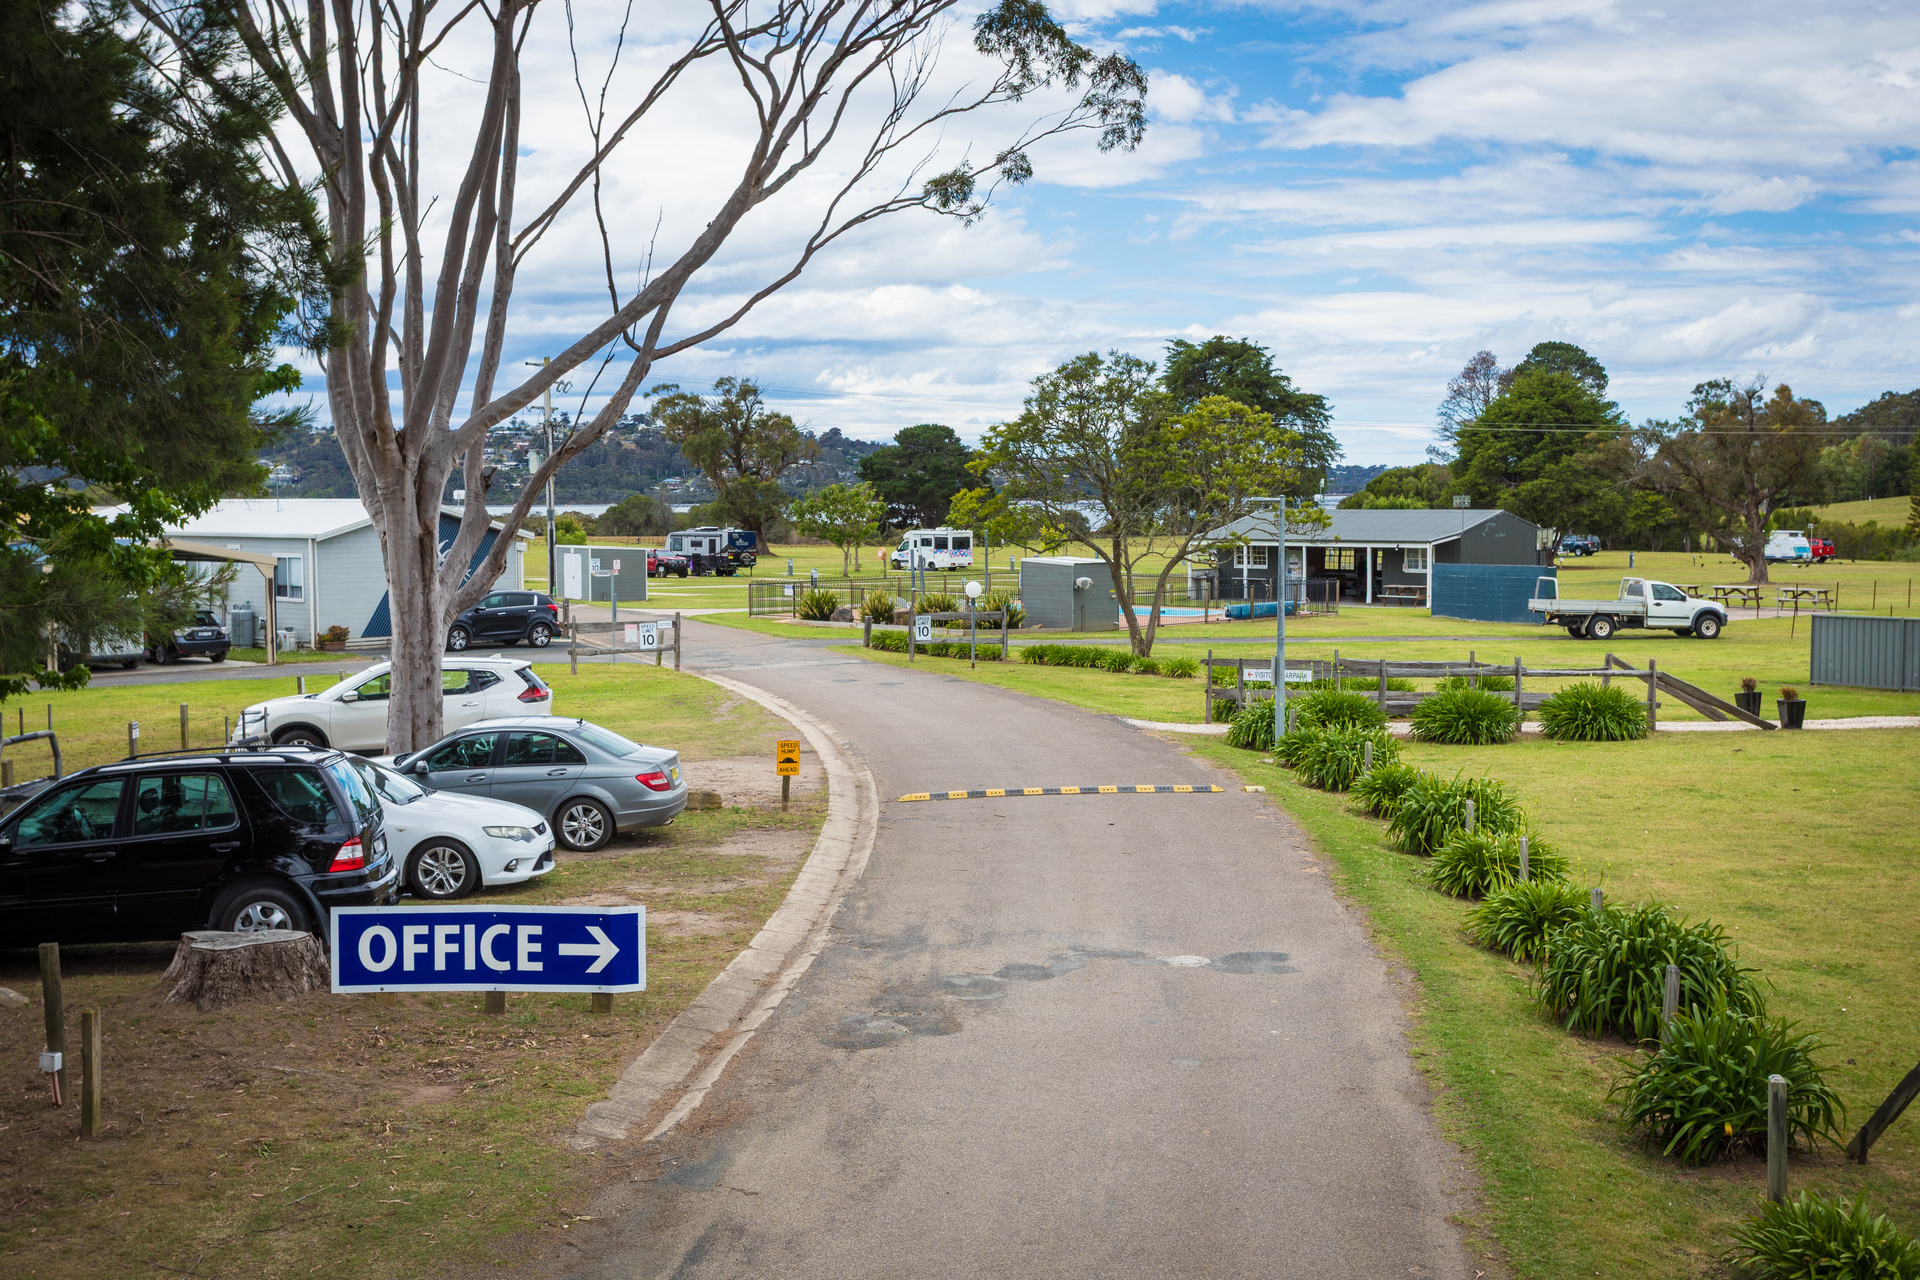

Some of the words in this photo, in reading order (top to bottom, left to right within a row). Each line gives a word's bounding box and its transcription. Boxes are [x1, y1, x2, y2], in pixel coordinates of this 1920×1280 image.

[918, 626, 929, 637] 10
[642, 634, 655, 646] 10
[358, 924, 544, 972] OFFICE
